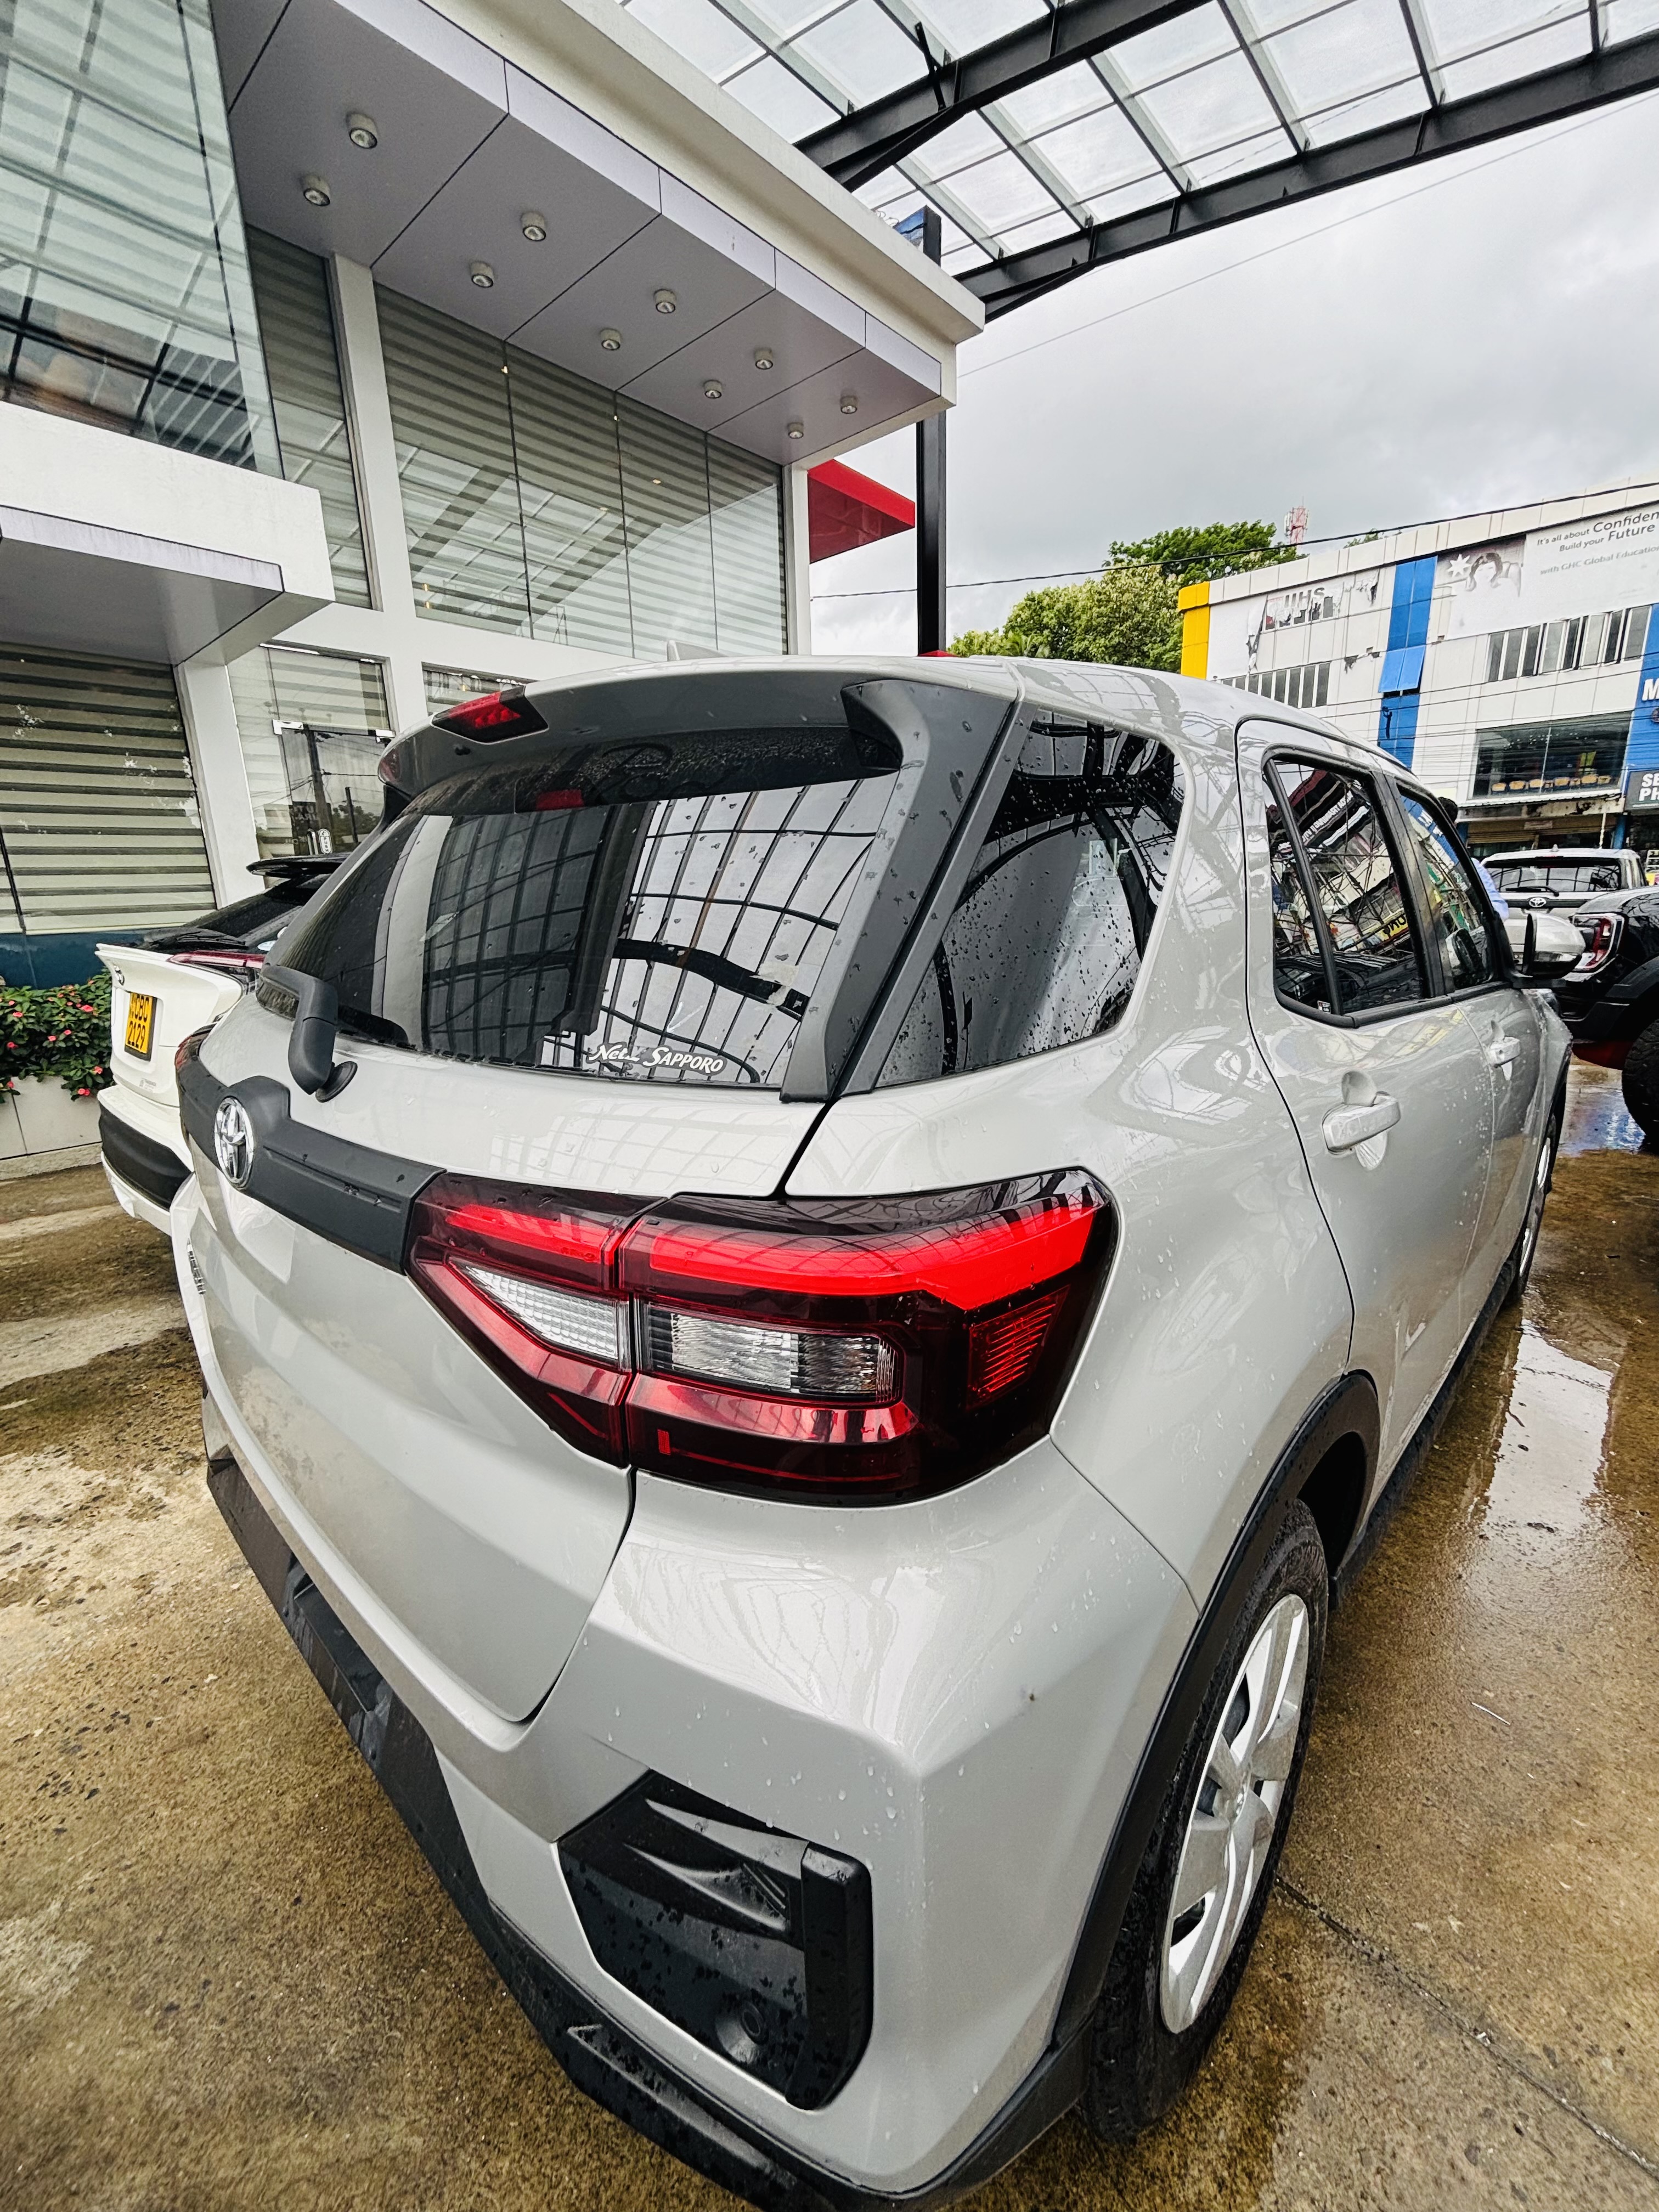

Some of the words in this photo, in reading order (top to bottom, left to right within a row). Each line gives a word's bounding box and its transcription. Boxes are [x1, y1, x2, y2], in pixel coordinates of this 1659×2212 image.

[1551, 534, 1562, 543] all
[1563, 528, 1590, 540] about
[1559, 541, 1582, 552] Build
[1583, 537, 1604, 549] your
[1607, 523, 1656, 541] Future
[1540, 566, 1560, 575] with
[1561, 560, 1582, 571] GHC
[1583, 554, 1614, 566] Global
[134, 994, 149, 1023] CBC
[127, 1020, 146, 1050] 2129
[588, 1044, 641, 1062] Net
